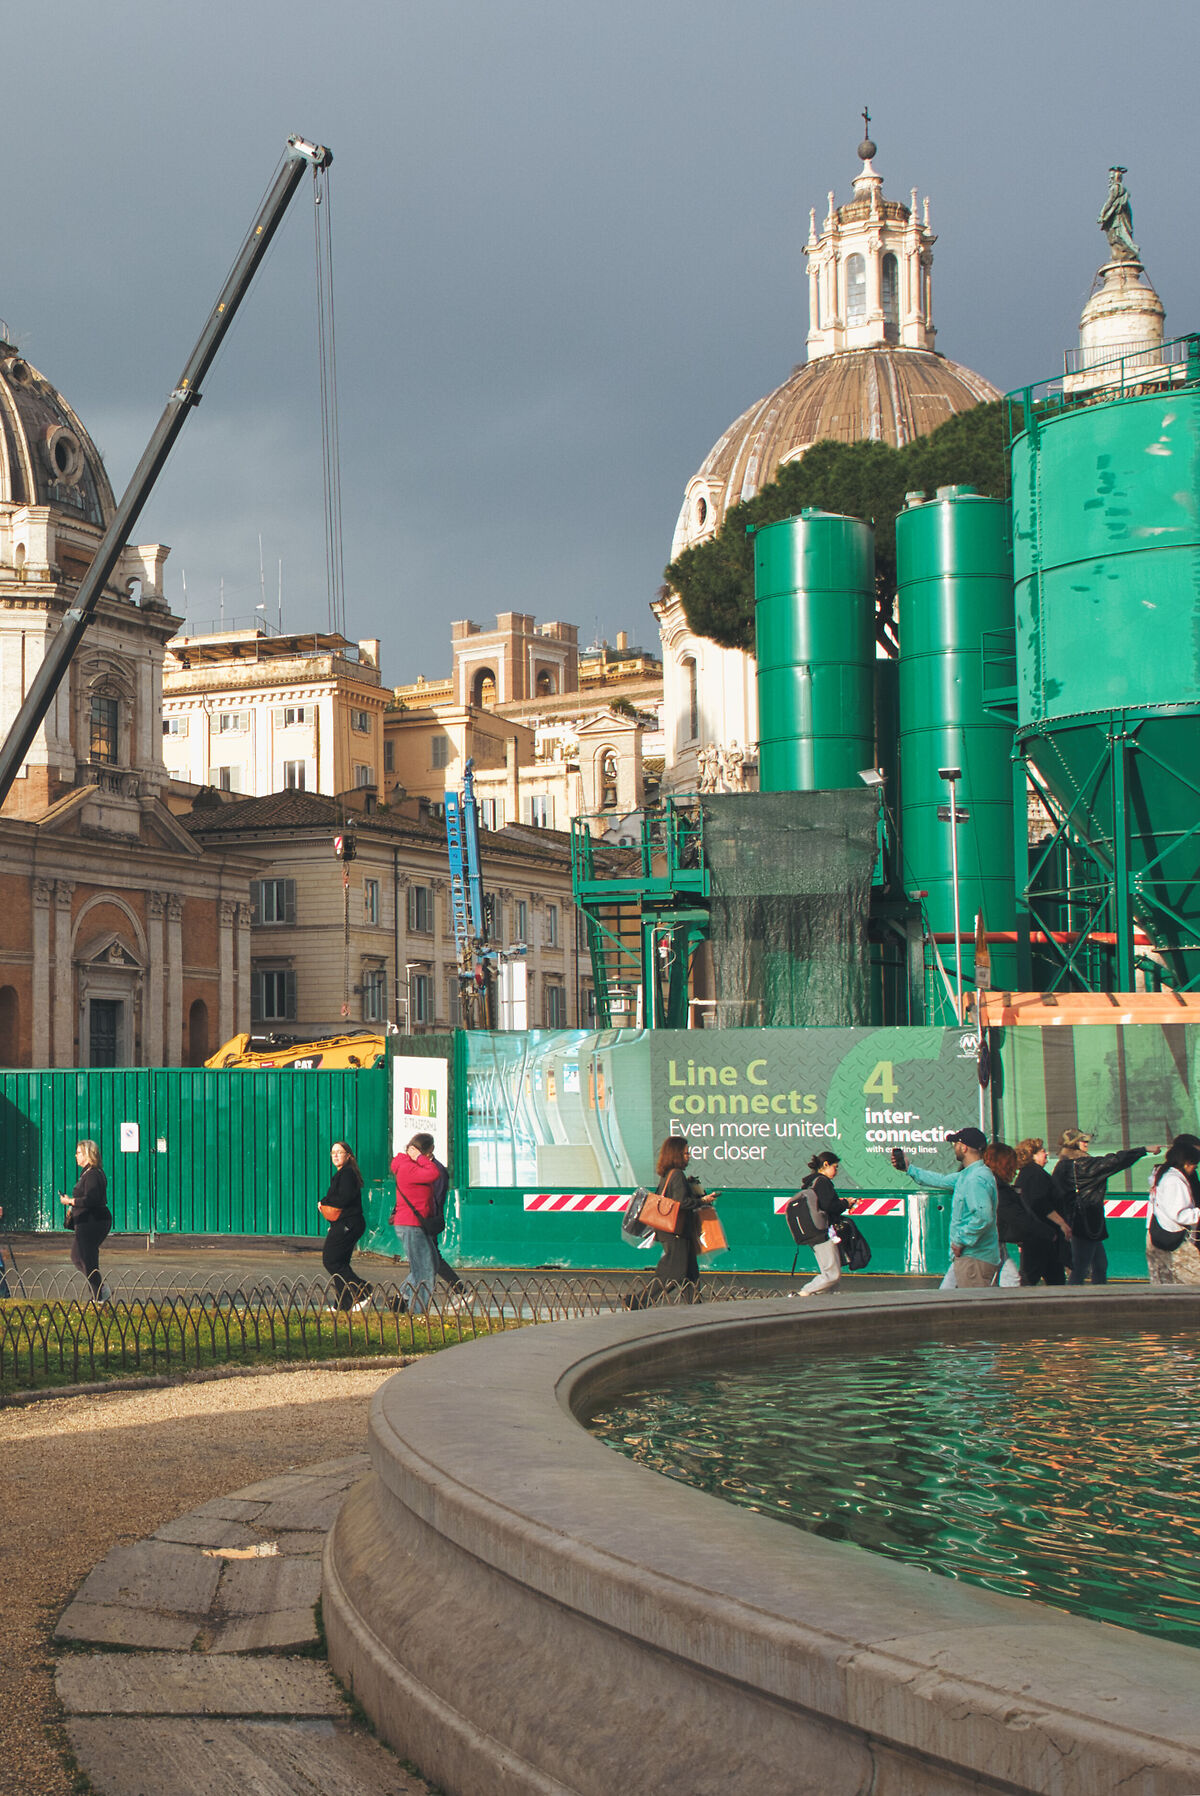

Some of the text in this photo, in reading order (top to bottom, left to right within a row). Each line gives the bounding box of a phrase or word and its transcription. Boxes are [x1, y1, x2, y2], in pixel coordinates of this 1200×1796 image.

[294, 1060, 313, 1069] CAT
[668, 1059, 768, 1086] Line C
[863, 1061, 898, 1103] 4
[405, 1091, 436, 1113] ROMA
[668, 1090, 818, 1115] connects
[865, 1107, 919, 1124] inter-
[669, 1118, 842, 1140] Even more united,
[865, 1126, 962, 1142] connectio
[713, 1141, 767, 1160] closer
[865, 1145, 884, 1153] with
[918, 1145, 938, 1154] lines
